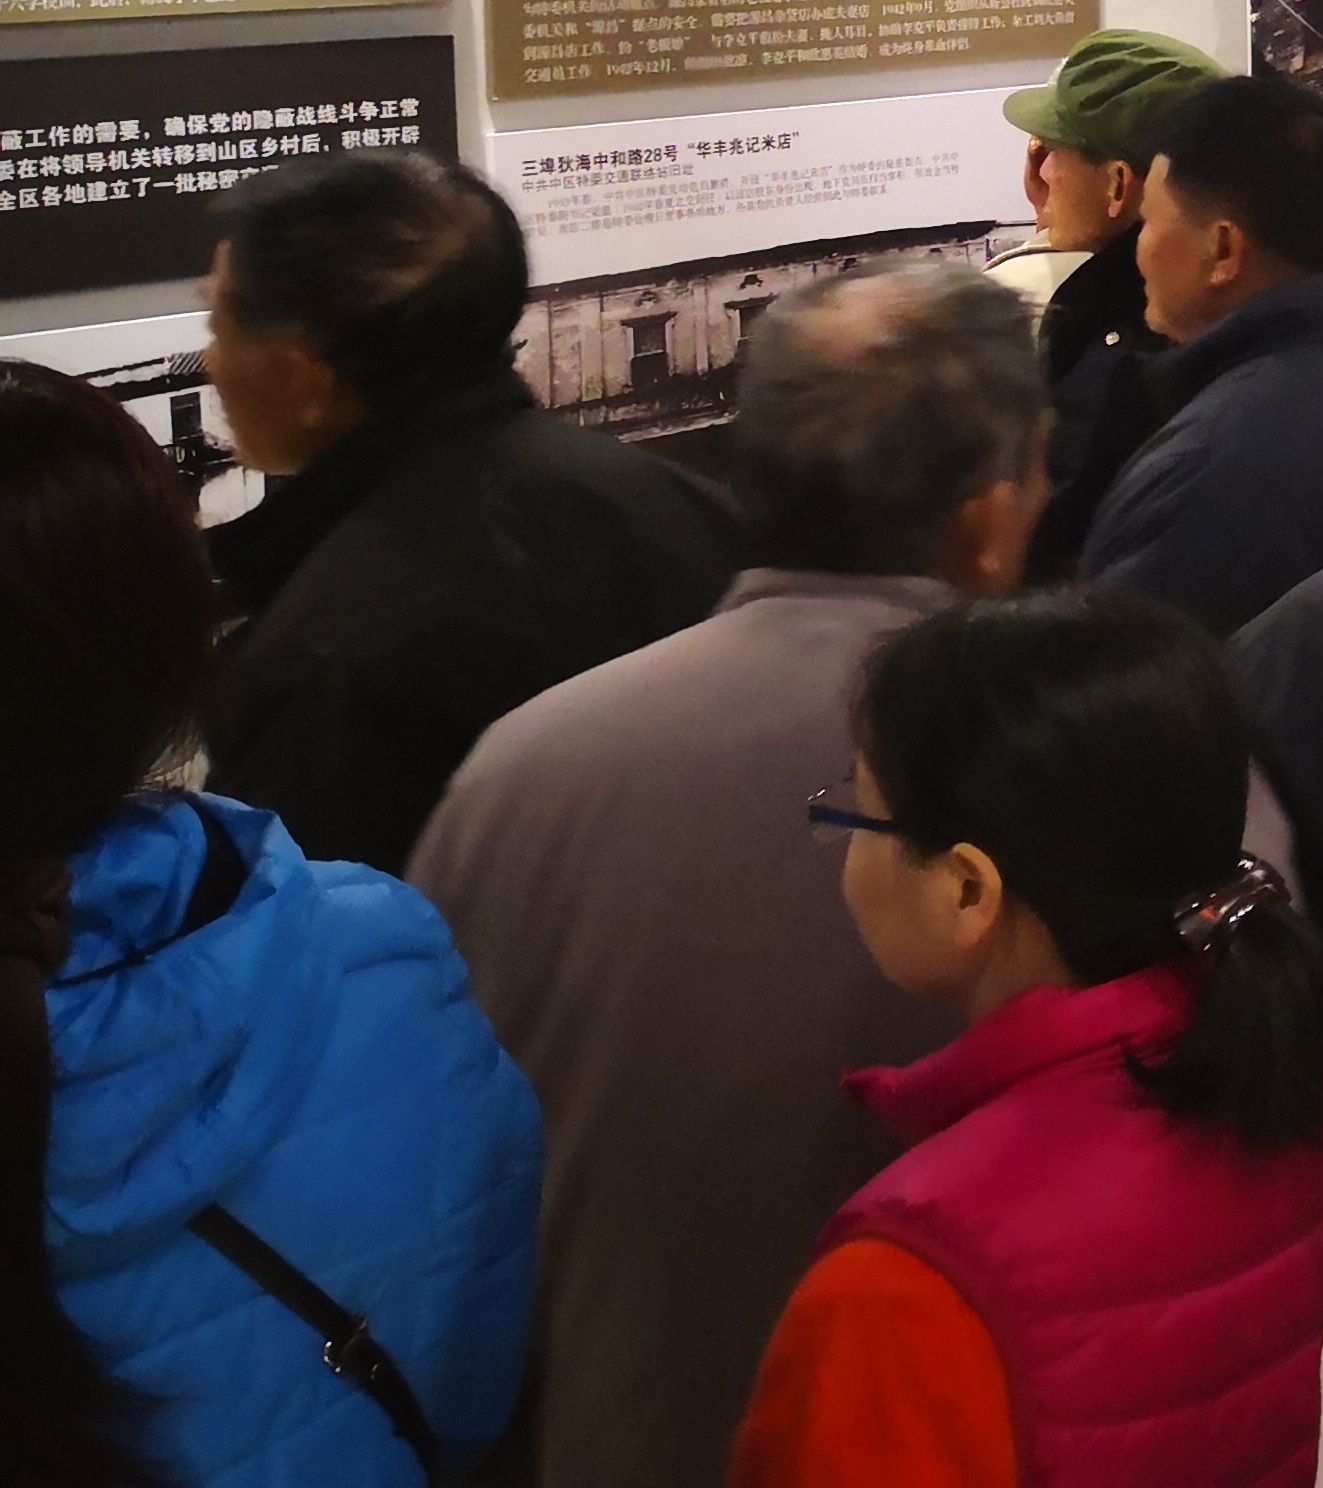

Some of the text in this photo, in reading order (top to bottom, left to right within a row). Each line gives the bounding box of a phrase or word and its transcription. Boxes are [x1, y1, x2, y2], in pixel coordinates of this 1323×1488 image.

[1, 97, 420, 151] 蔽工作的需要，确保党的隐蔽战线斗争正常
